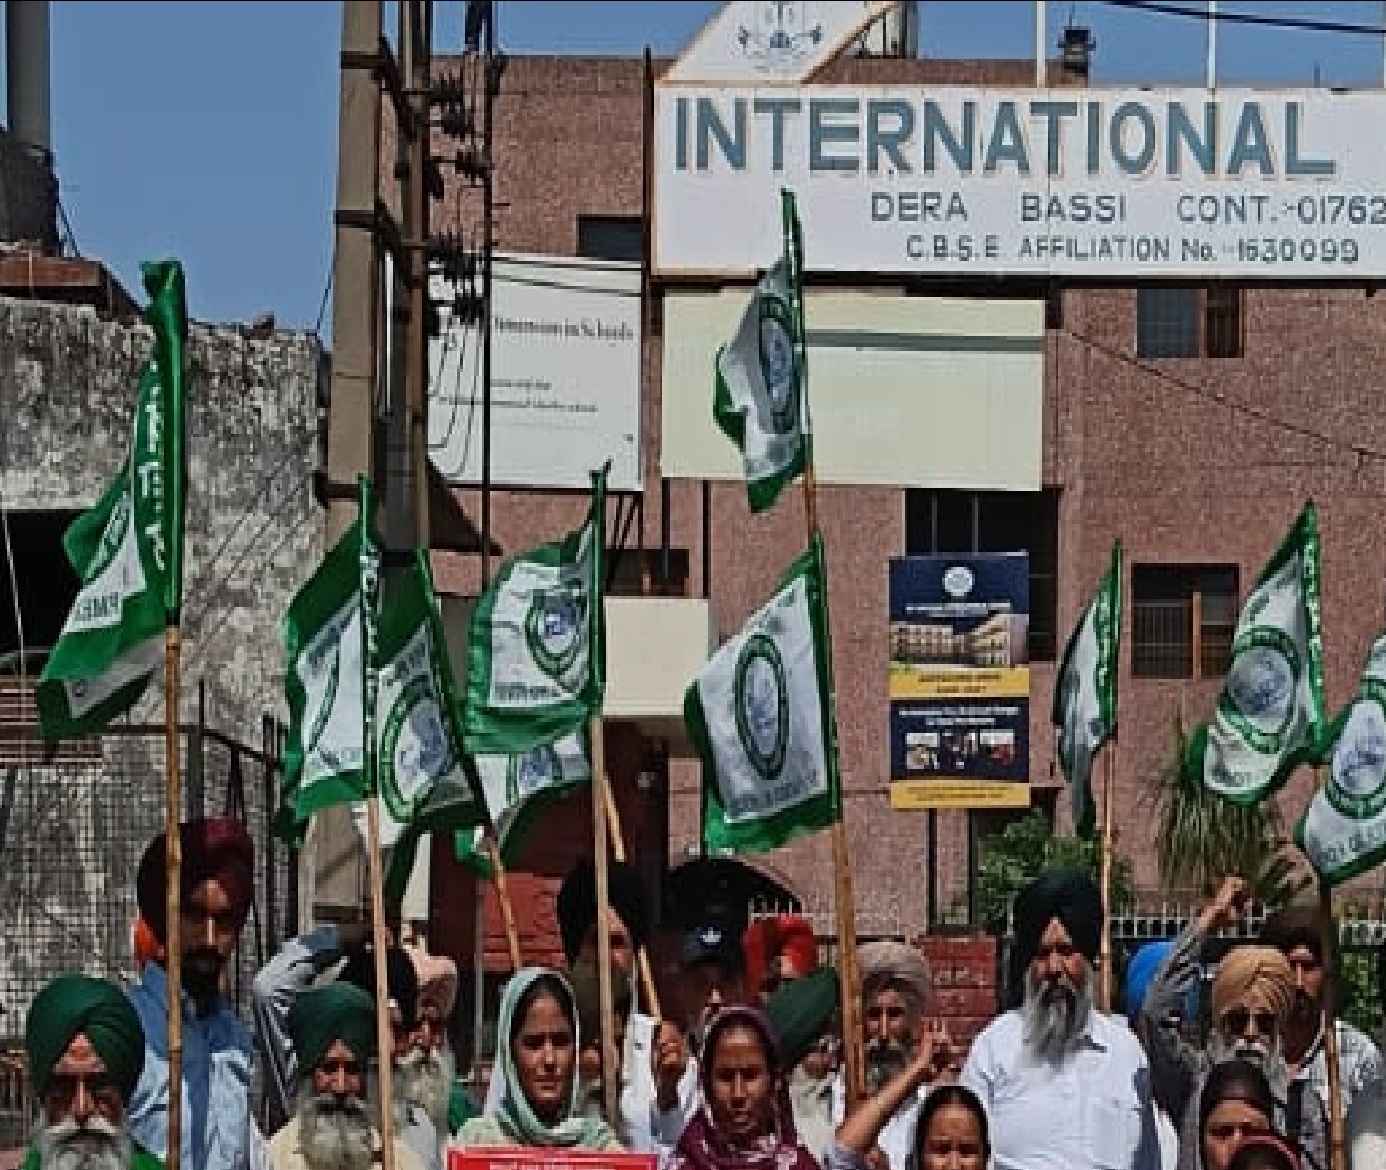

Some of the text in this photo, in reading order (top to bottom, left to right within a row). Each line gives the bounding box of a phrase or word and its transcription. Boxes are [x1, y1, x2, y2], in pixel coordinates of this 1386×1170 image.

[673, 98, 1336, 180] INTERNATIONAL
[870, 190, 969, 223] DERA
[1020, 193, 1127, 223] BASSI
[1019, 237, 1170, 262] AFFILIATION
